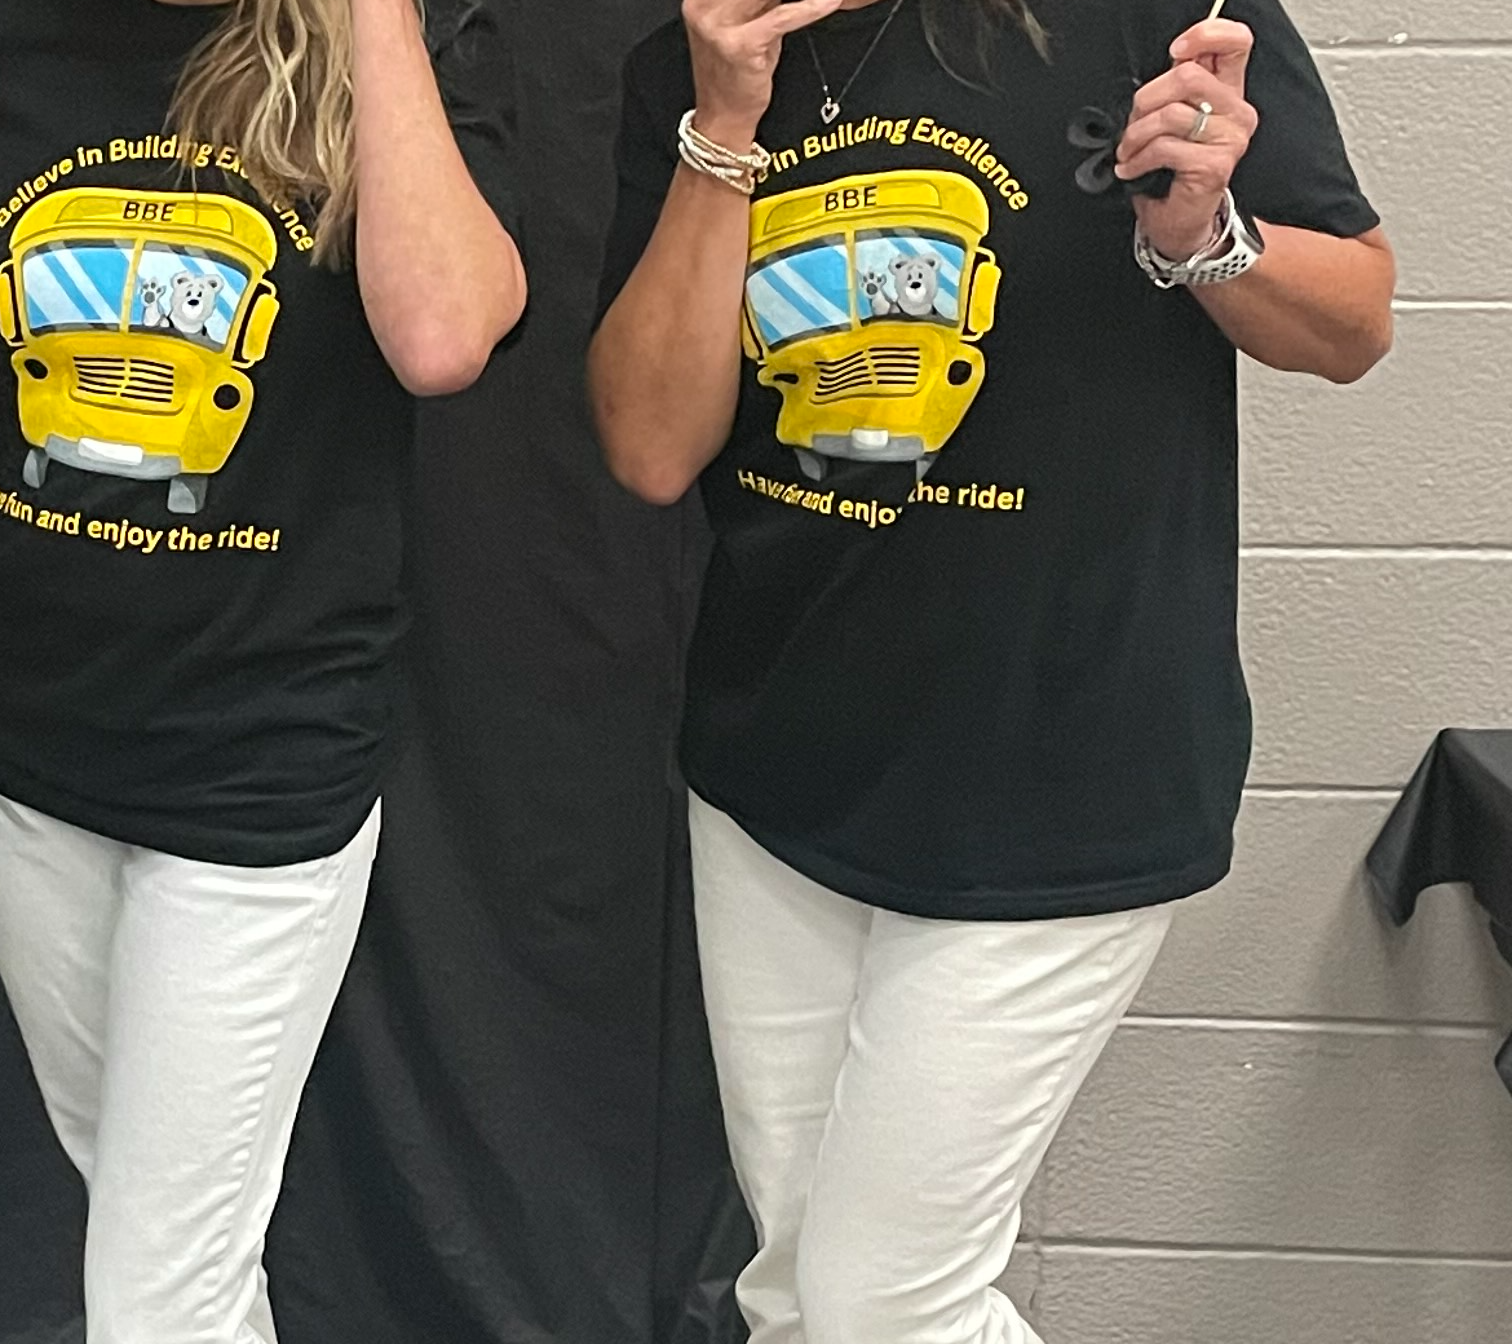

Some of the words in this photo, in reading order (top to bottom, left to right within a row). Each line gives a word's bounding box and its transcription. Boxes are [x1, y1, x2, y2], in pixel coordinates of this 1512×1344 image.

[77, 146, 103, 167] in
[772, 147, 799, 173] in
[802, 115, 911, 157] Building
[911, 117, 1029, 210] Excellence
[122, 201, 179, 222] BBE
[823, 185, 878, 213] BBE
[4, 492, 33, 523] fun
[36, 509, 81, 536] and
[87, 519, 165, 554] enjoy
[167, 526, 213, 552] the
[217, 524, 280, 552] ride!
[839, 499, 903, 529] enjo
[957, 483, 1025, 510] ride!
